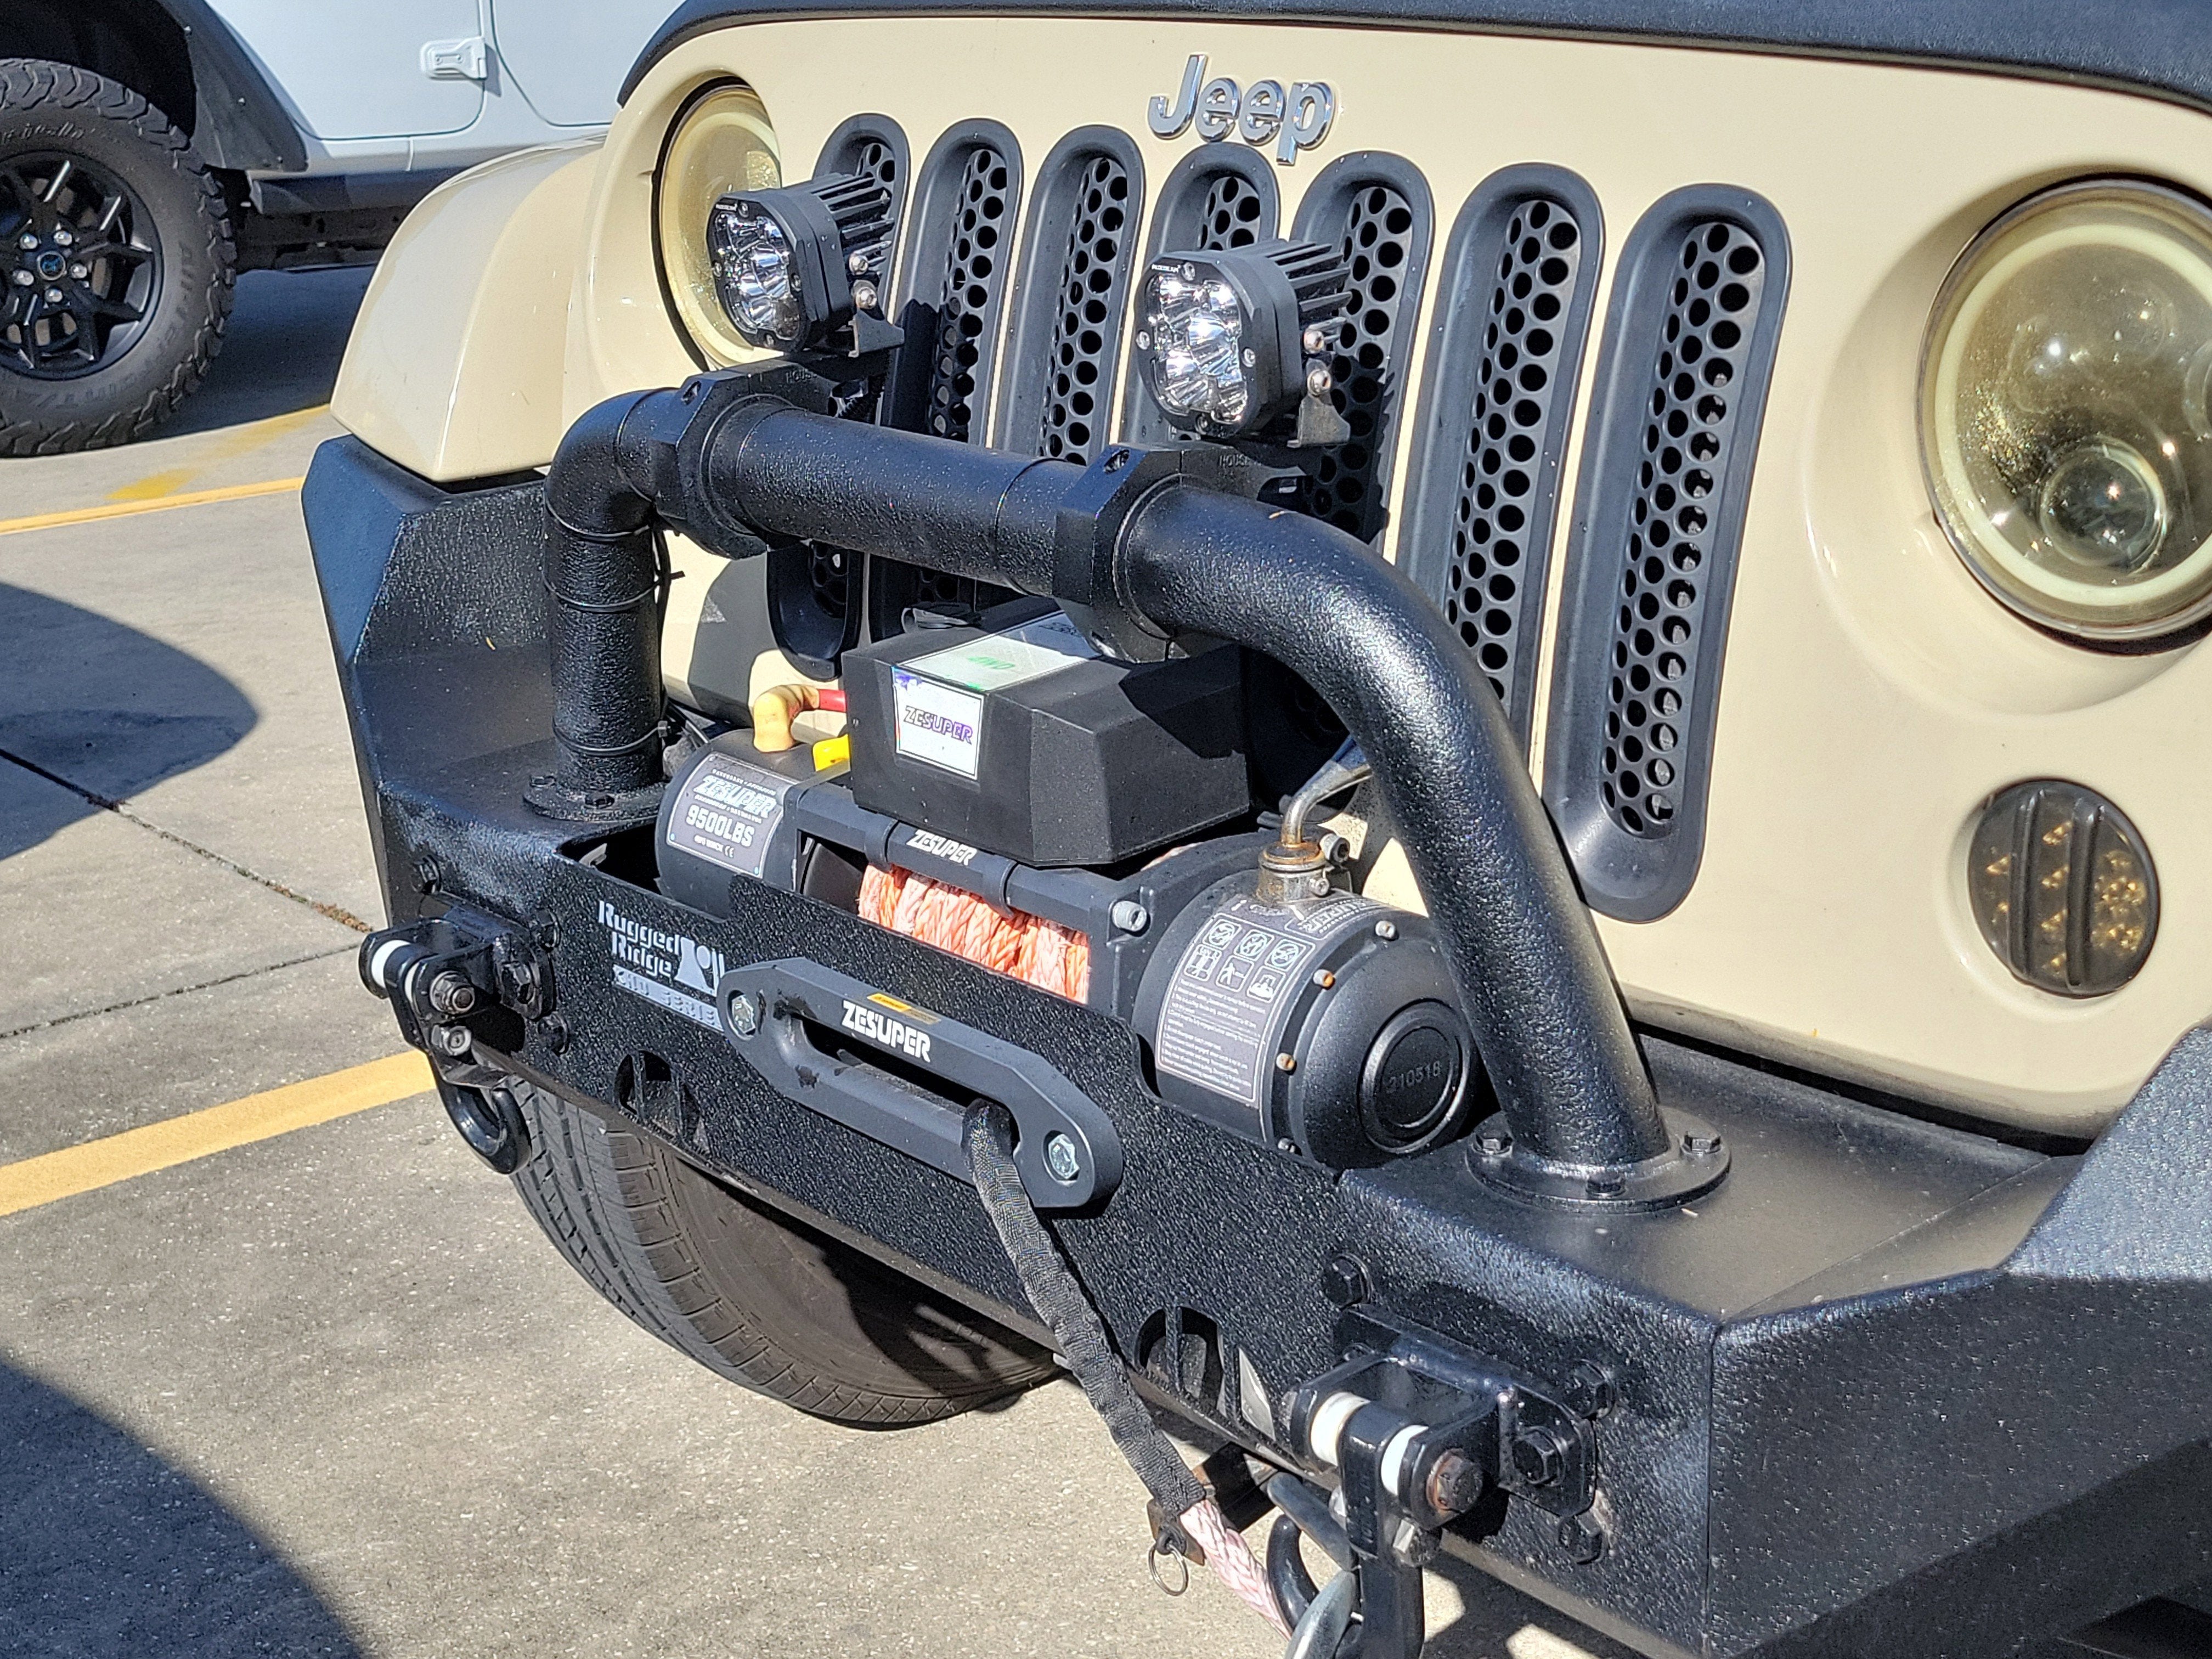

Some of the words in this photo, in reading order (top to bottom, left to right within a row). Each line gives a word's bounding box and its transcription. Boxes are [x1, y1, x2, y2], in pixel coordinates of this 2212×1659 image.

[1147, 53, 1335, 166] Jeep
[903, 704, 973, 745] ZESUPER
[693, 774, 777, 819] ZESUPER
[686, 804, 755, 847] 9500LBS
[906, 829, 978, 866] ZESUPER
[598, 900, 680, 955] Rugged
[612, 931, 672, 978] Ridge
[841, 1000, 931, 1063] ZESUPER
